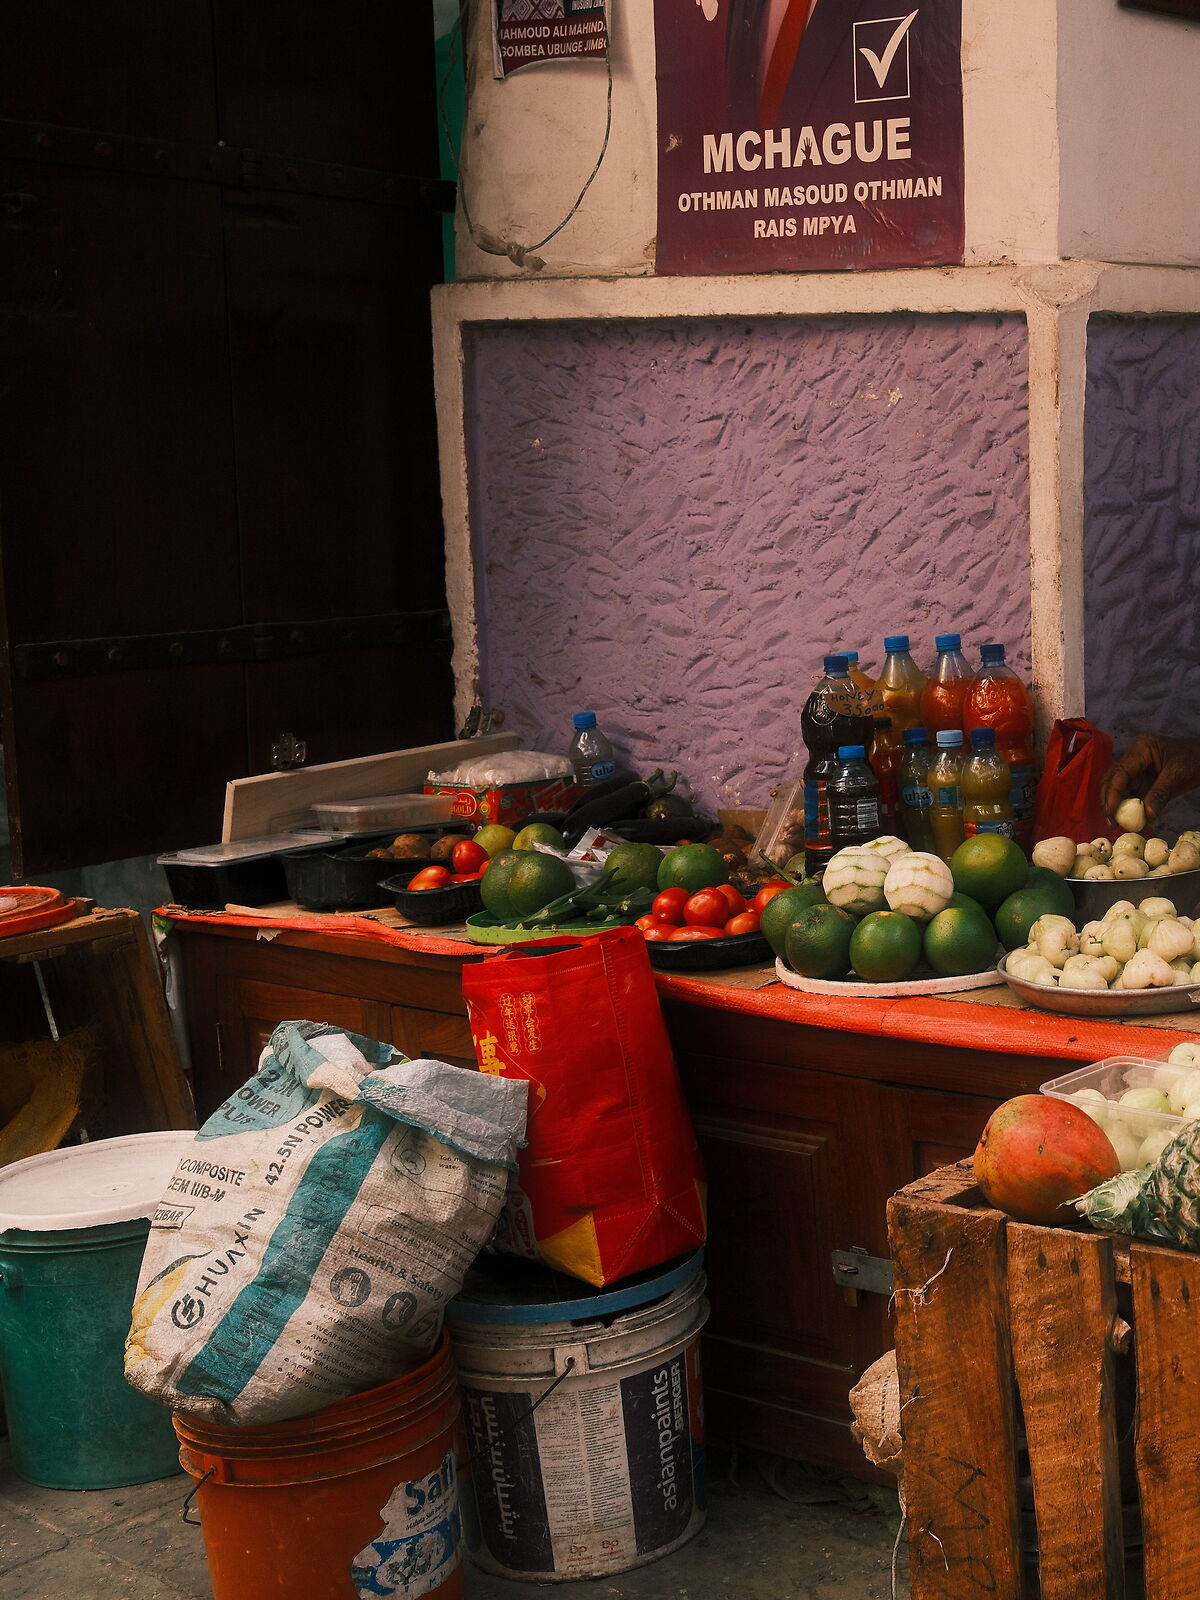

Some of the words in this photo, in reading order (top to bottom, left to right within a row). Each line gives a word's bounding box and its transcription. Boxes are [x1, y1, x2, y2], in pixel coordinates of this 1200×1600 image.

[552, 25, 568, 37] ALI
[547, 41, 583, 55] UBUNGE
[703, 117, 912, 174] MCHAGUE
[678, 189, 758, 212] OTHMAN
[764, 183, 848, 207] MASOUD
[854, 176, 942, 202] OTHMAN
[753, 218, 797, 238] RAIS
[803, 214, 857, 236] MPYA
[831, 690, 875, 701] HONEY
[264, 1135, 303, 1186] 42.5N
[294, 1098, 354, 1135] POWER
[180, 1158, 246, 1186] COMPOSITE
[153, 1208, 184, 1222] ZIBAR
[194, 1207, 266, 1297] HUAXIN
[348, 1245, 397, 1274] Health
[396, 1267, 408, 1280] &
[409, 1273, 444, 1301] Safety
[304, 1344, 313, 1352] IN
[310, 1333, 328, 1345] AND
[300, 1352, 324, 1367] WATER
[671, 1361, 684, 1432] BERGER
[651, 1369, 677, 1512] asianpaints
